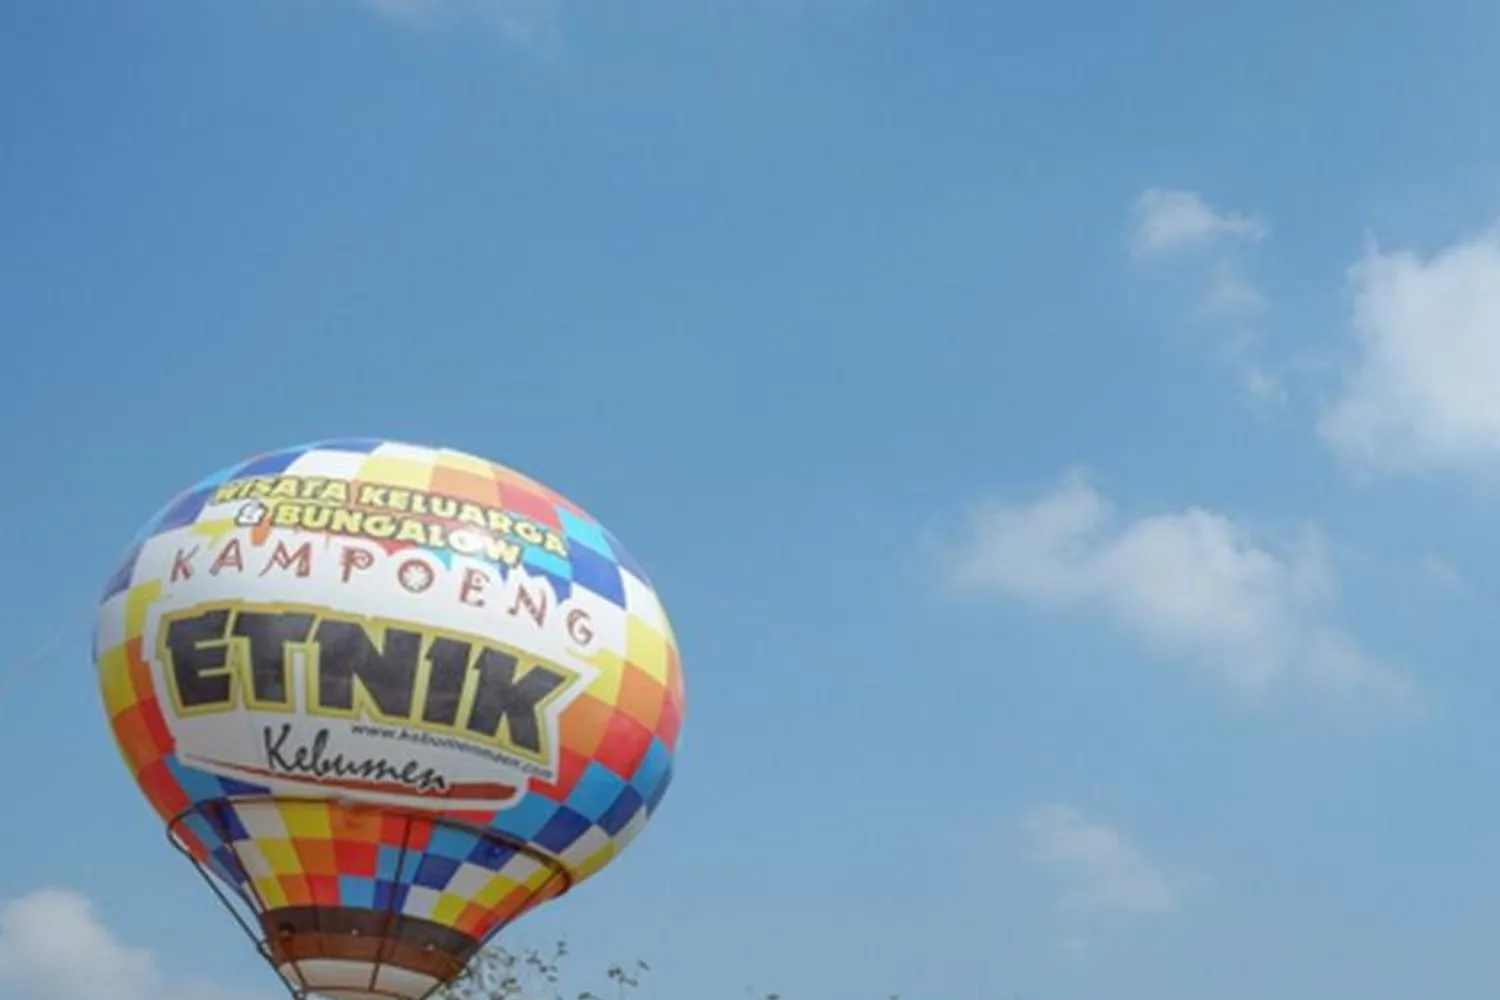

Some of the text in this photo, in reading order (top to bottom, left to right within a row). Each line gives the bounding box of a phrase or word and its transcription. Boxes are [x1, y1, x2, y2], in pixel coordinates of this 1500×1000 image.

[214, 475, 569, 557] WISATA KELUARGA
[235, 499, 524, 568] & BUNGALOW
[169, 538, 594, 647] KAMPOENG
[163, 606, 568, 755] ETNIK
[262, 724, 446, 791] Kebumen
